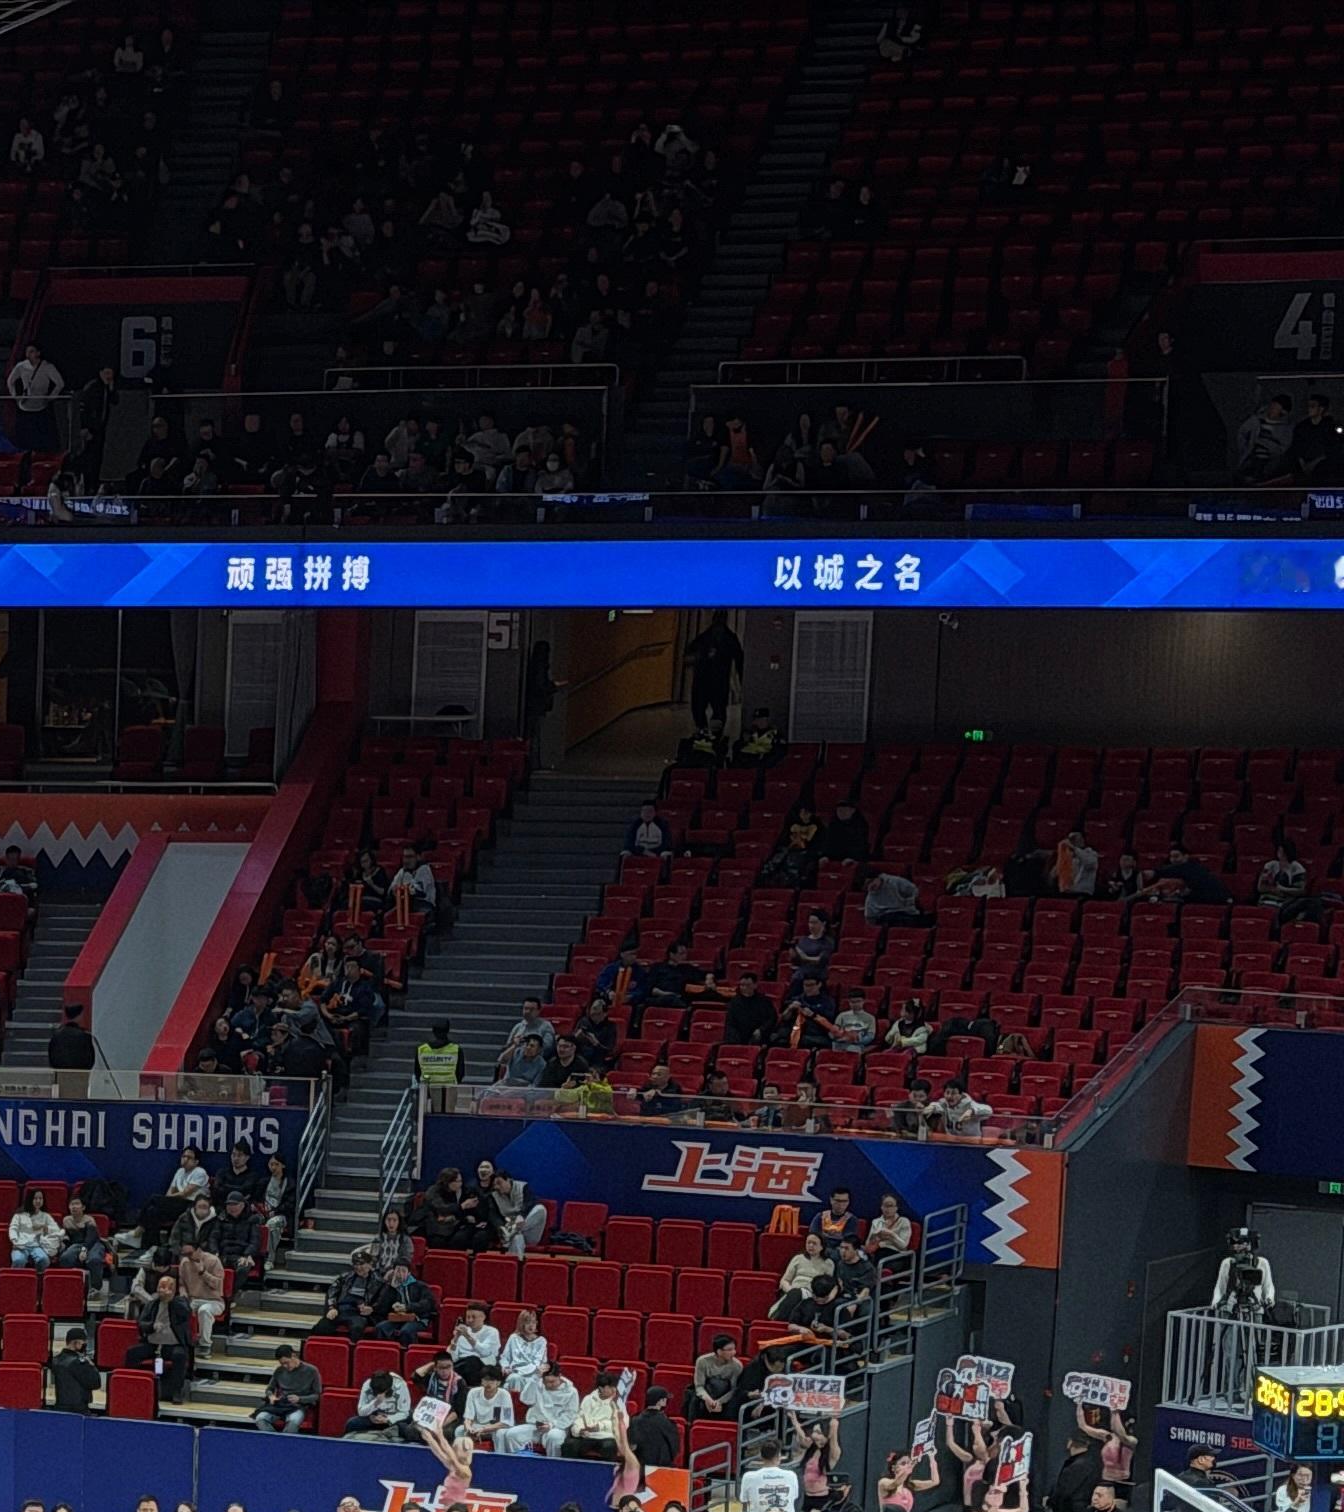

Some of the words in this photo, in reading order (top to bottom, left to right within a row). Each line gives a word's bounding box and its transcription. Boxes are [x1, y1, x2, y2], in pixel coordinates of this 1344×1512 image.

[120, 316, 157, 378] 6
[1273, 292, 1317, 361] 4
[226, 556, 371, 592] 顽强拼搏
[773, 554, 921, 591] 以城之名
[487, 611, 511, 650] 5
[132, 1111, 281, 1155] SHARKS
[640, 1140, 824, 1203] 上海
[1169, 1426, 1225, 1447] SHANGHAI
